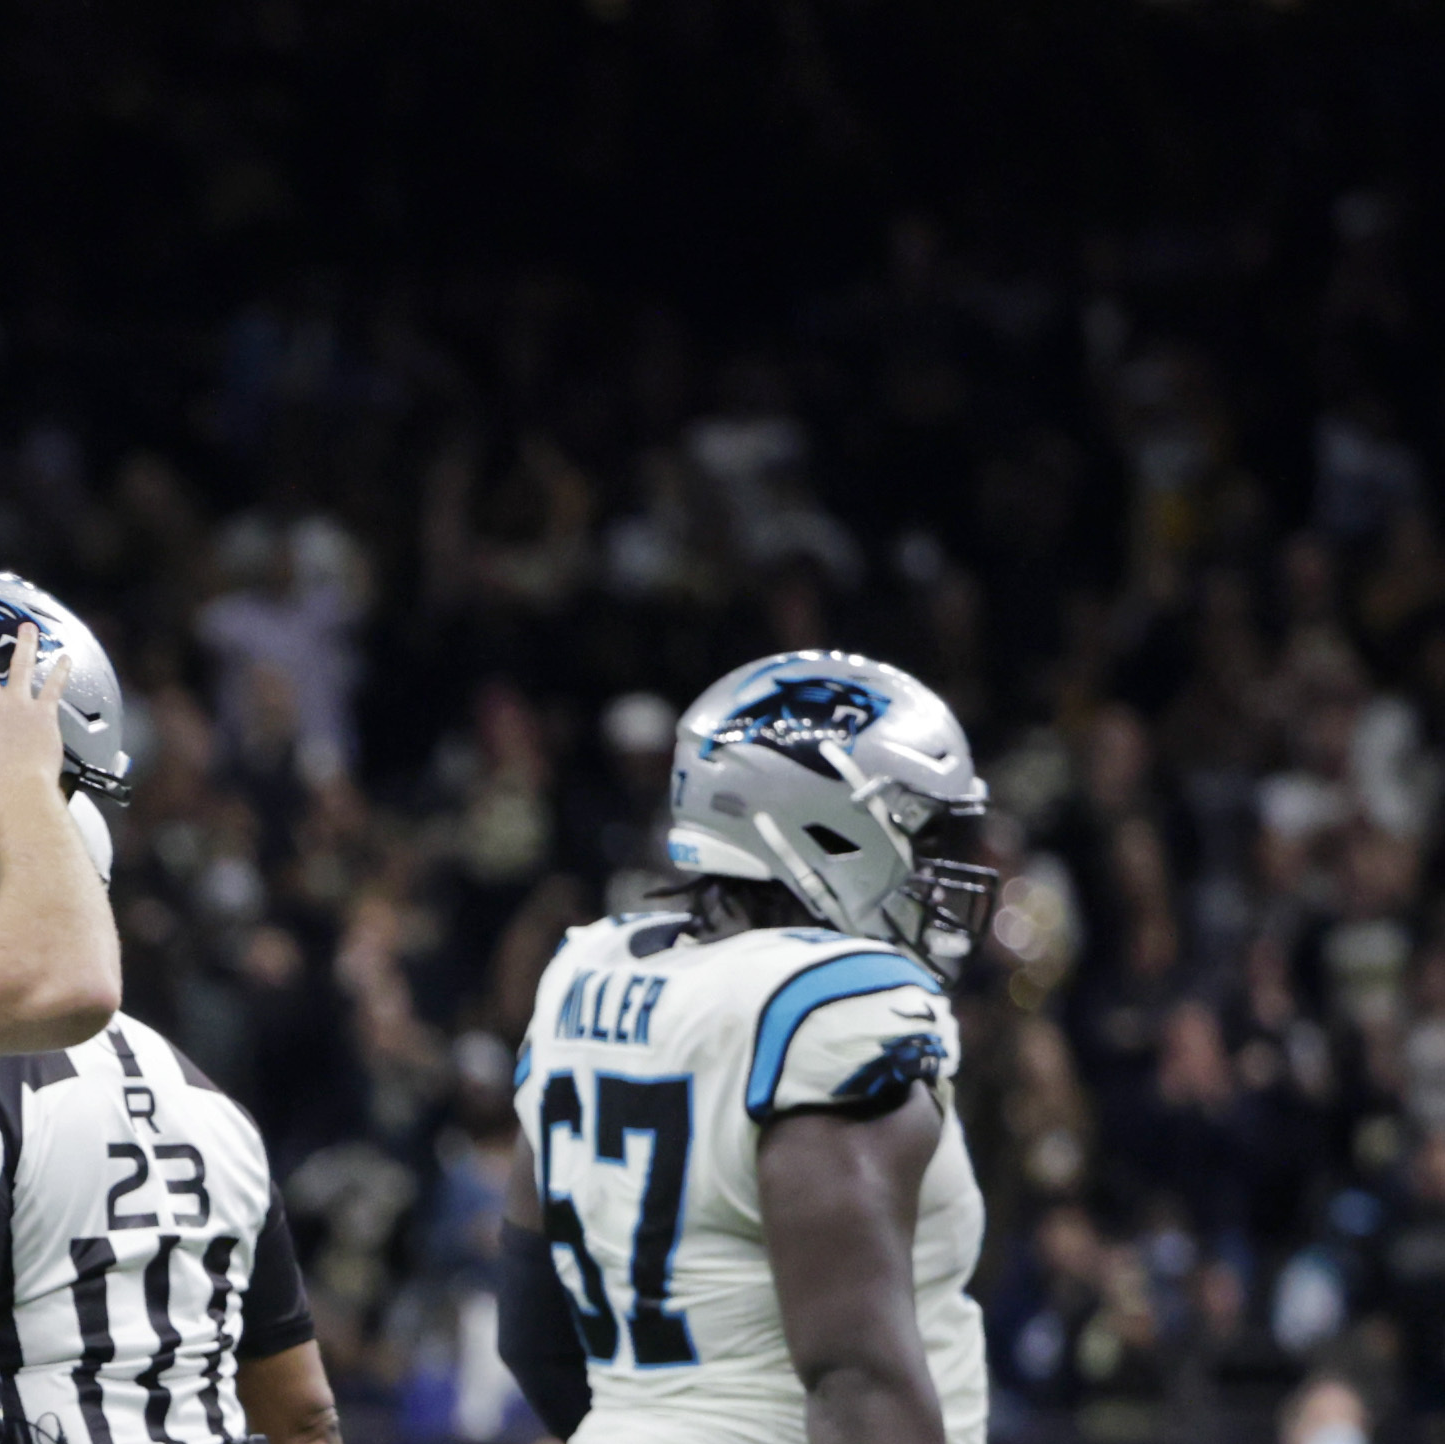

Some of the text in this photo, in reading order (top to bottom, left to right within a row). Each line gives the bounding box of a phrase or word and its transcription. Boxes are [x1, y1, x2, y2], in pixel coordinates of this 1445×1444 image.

[123, 1085, 161, 1134] R
[106, 1142, 211, 1232] 23
[540, 1070, 701, 1370] 67
